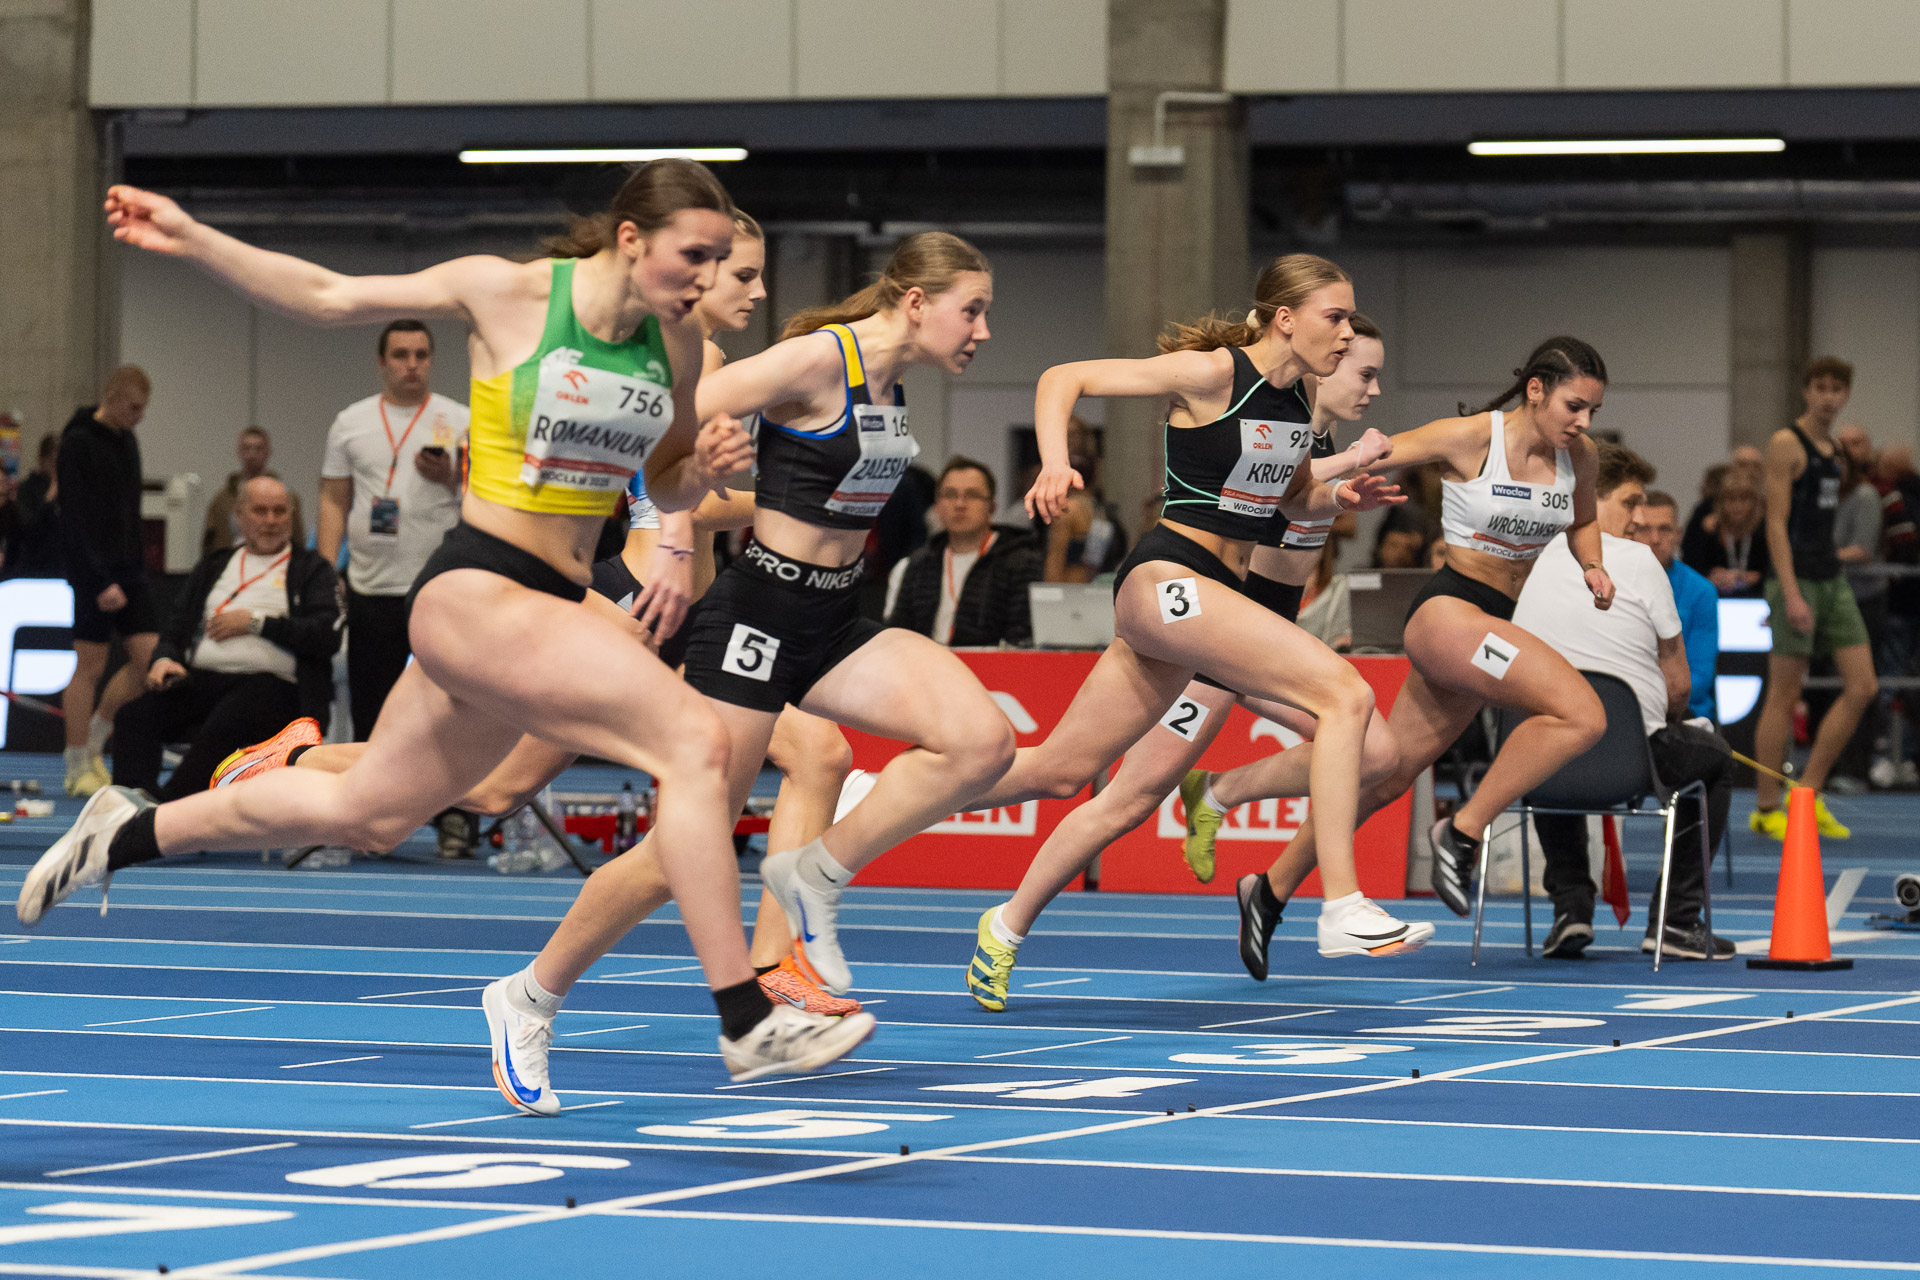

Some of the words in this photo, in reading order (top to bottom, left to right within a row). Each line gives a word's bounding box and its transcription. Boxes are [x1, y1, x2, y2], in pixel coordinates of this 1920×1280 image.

[618, 385, 664, 418] 756
[534, 415, 656, 458] ROMANIUK
[1252, 442, 1274, 450] ORLEN
[1245, 462, 1296, 484] KRUP
[1541, 491, 1569, 510] 305
[804, 569, 852, 590] NIKE
[1165, 582, 1190, 617] 3
[736, 632, 768, 673] 5
[1483, 643, 1510, 663] 1
[1168, 701, 1199, 736] 2
[1614, 993, 1757, 1010] 1
[1355, 1016, 1607, 1037] 2
[1169, 1043, 1415, 1066] 3
[918, 1077, 1199, 1099] 4
[636, 1109, 955, 1139] 5
[285, 1153, 631, 1189] 6
[0, 1202, 296, 1246] 7
